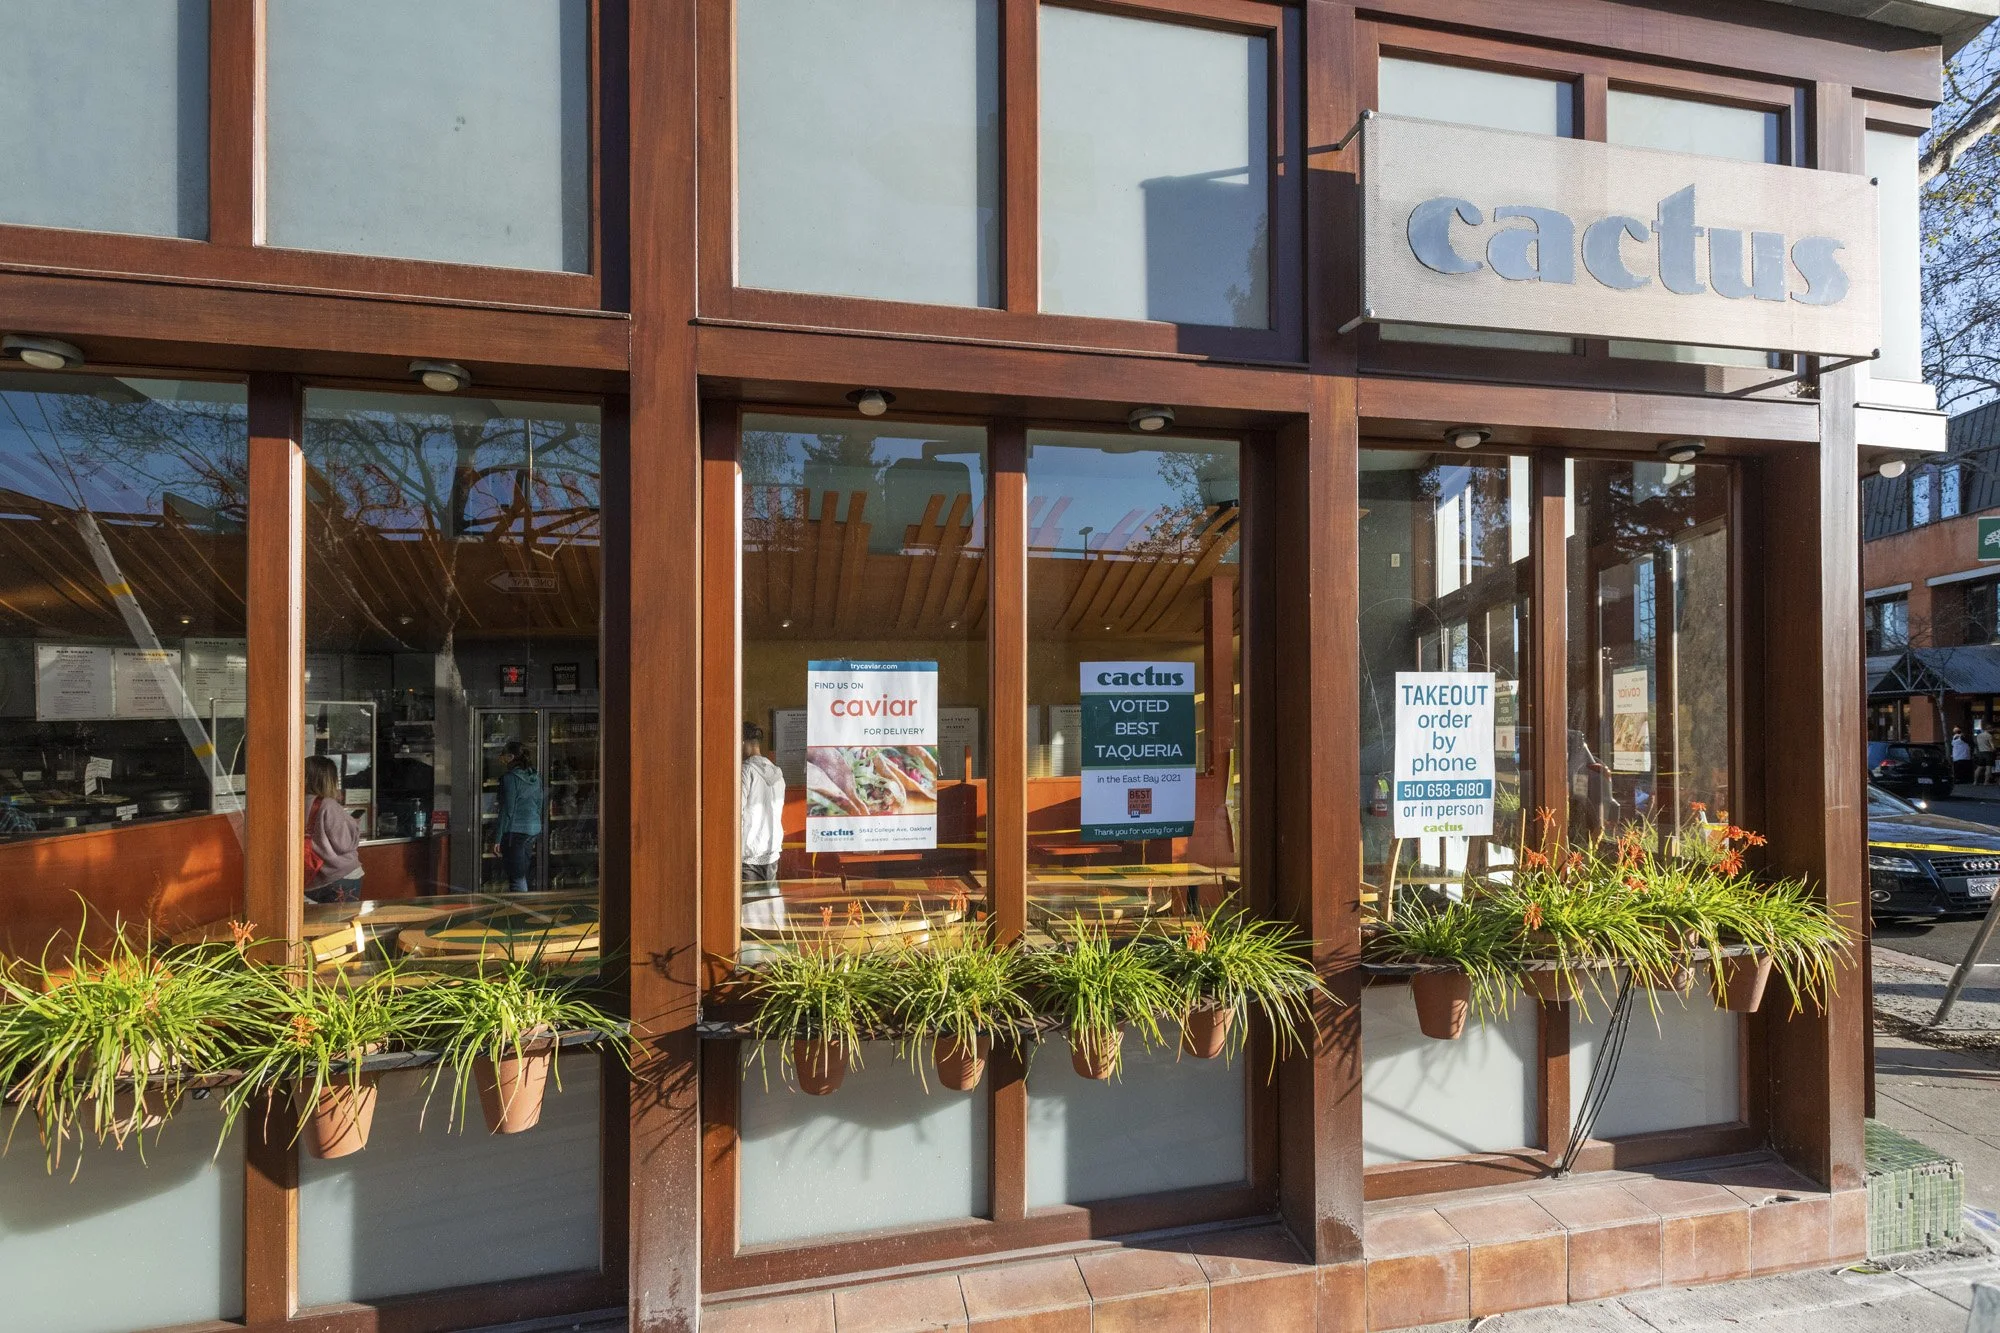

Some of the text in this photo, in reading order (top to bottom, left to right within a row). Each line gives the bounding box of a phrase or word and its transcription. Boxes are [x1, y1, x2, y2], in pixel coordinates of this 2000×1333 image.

[1406, 183, 1850, 307] cactus
[1097, 665, 1184, 686] cactus
[1401, 685, 1488, 706] TAKEOUT
[830, 694, 918, 717] caviar
[1109, 699, 1170, 713] VOTED
[1417, 710, 1472, 729] order
[1115, 722, 1160, 735] BEST
[1432, 731, 1457, 753] by
[1094, 744, 1183, 761] TAQUERIA
[1412, 753, 1477, 776] phone
[1107, 775, 1120, 783] the
[1122, 775, 1141, 783] East
[1143, 774, 1160, 784] Bay
[1161, 774, 1181, 782] 2021
[1129, 790, 1151, 799] BEST
[1404, 782, 1484, 798] 510 658-6180
[1403, 802, 1484, 820] or in person
[820, 828, 854, 836] cactus
[1094, 828, 1114, 836] Thank
[1141, 827, 1162, 835] voting
[1423, 821, 1463, 833] cactus
